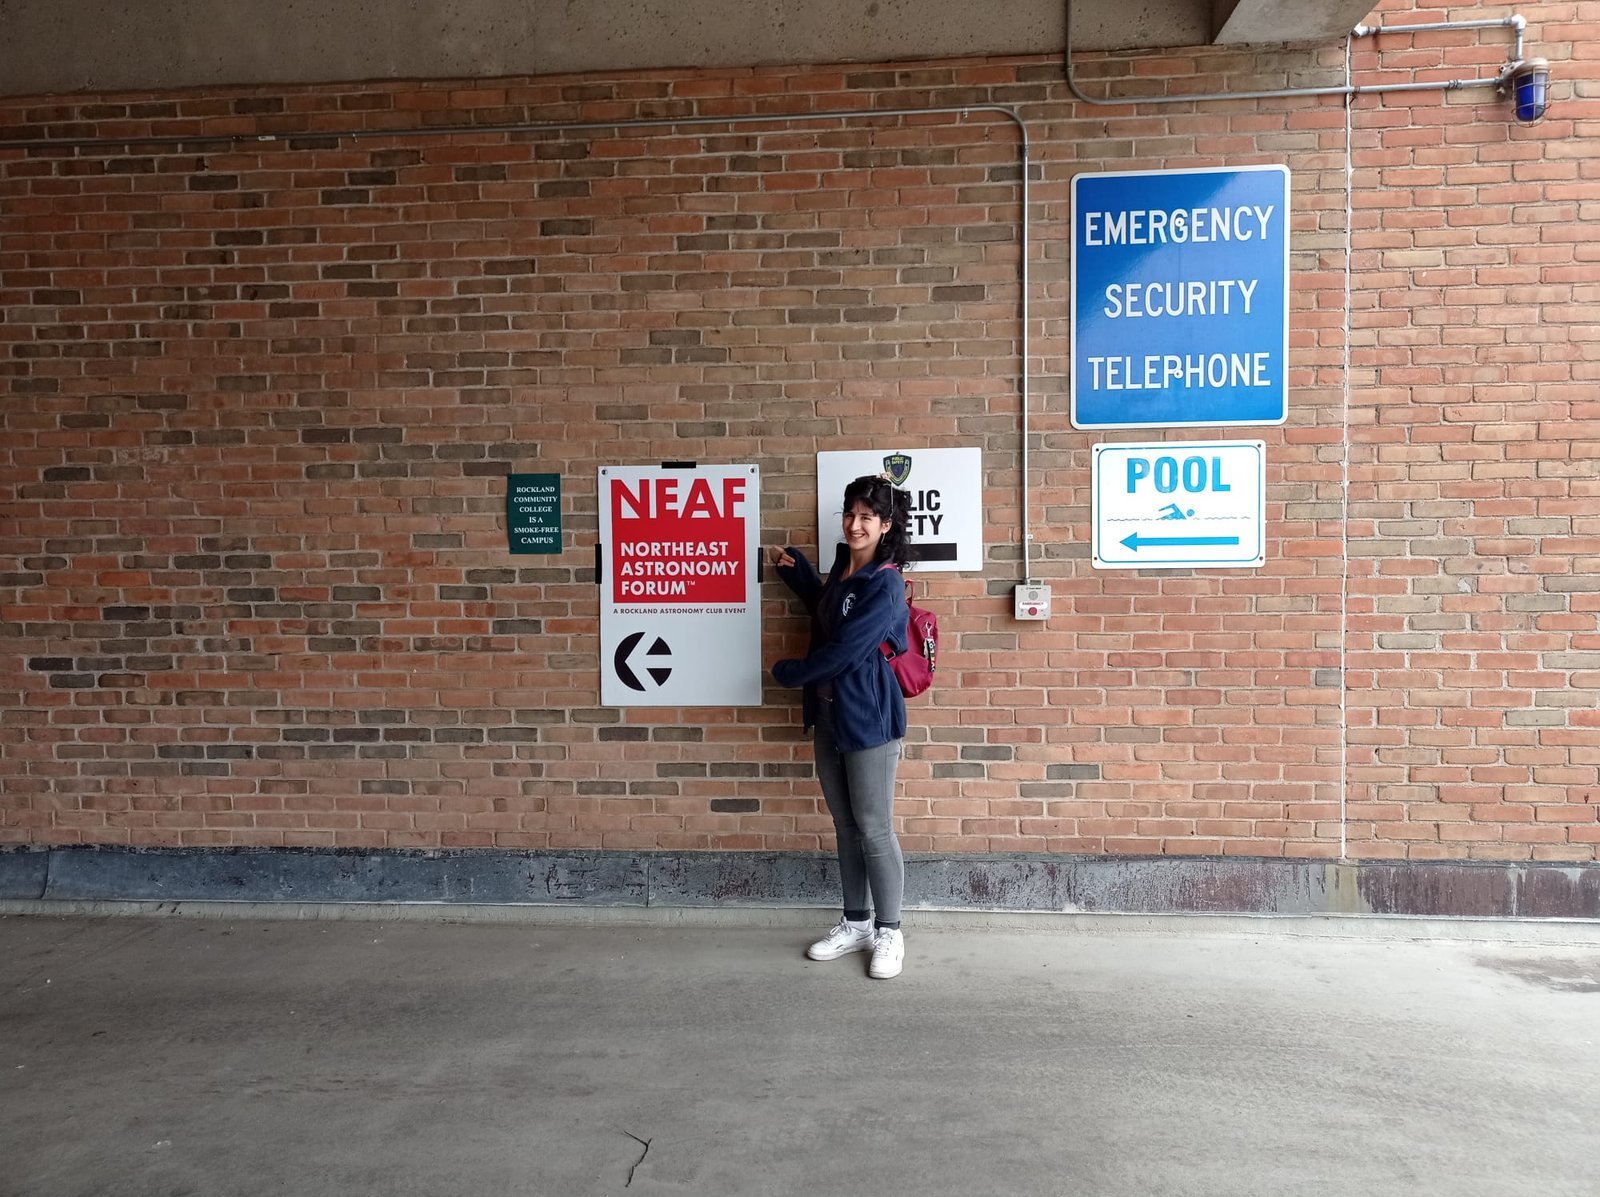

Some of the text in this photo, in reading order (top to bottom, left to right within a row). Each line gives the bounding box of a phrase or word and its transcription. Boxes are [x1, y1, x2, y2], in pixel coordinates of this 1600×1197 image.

[1085, 205, 1274, 246] EMERGENCY
[1103, 279, 1258, 319] SECURITY
[1088, 352, 1271, 391] TELEPHONE
[1127, 456, 1231, 493] POOL
[610, 478, 746, 519] NEAF
[907, 490, 941, 511] LIC
[514, 526, 559, 534] SMOKE-FREE
[529, 516, 543, 524] IS A
[906, 514, 943, 536] ETY
[620, 541, 729, 557] NORTHEAST
[620, 560, 739, 576] ASTRONOMY
